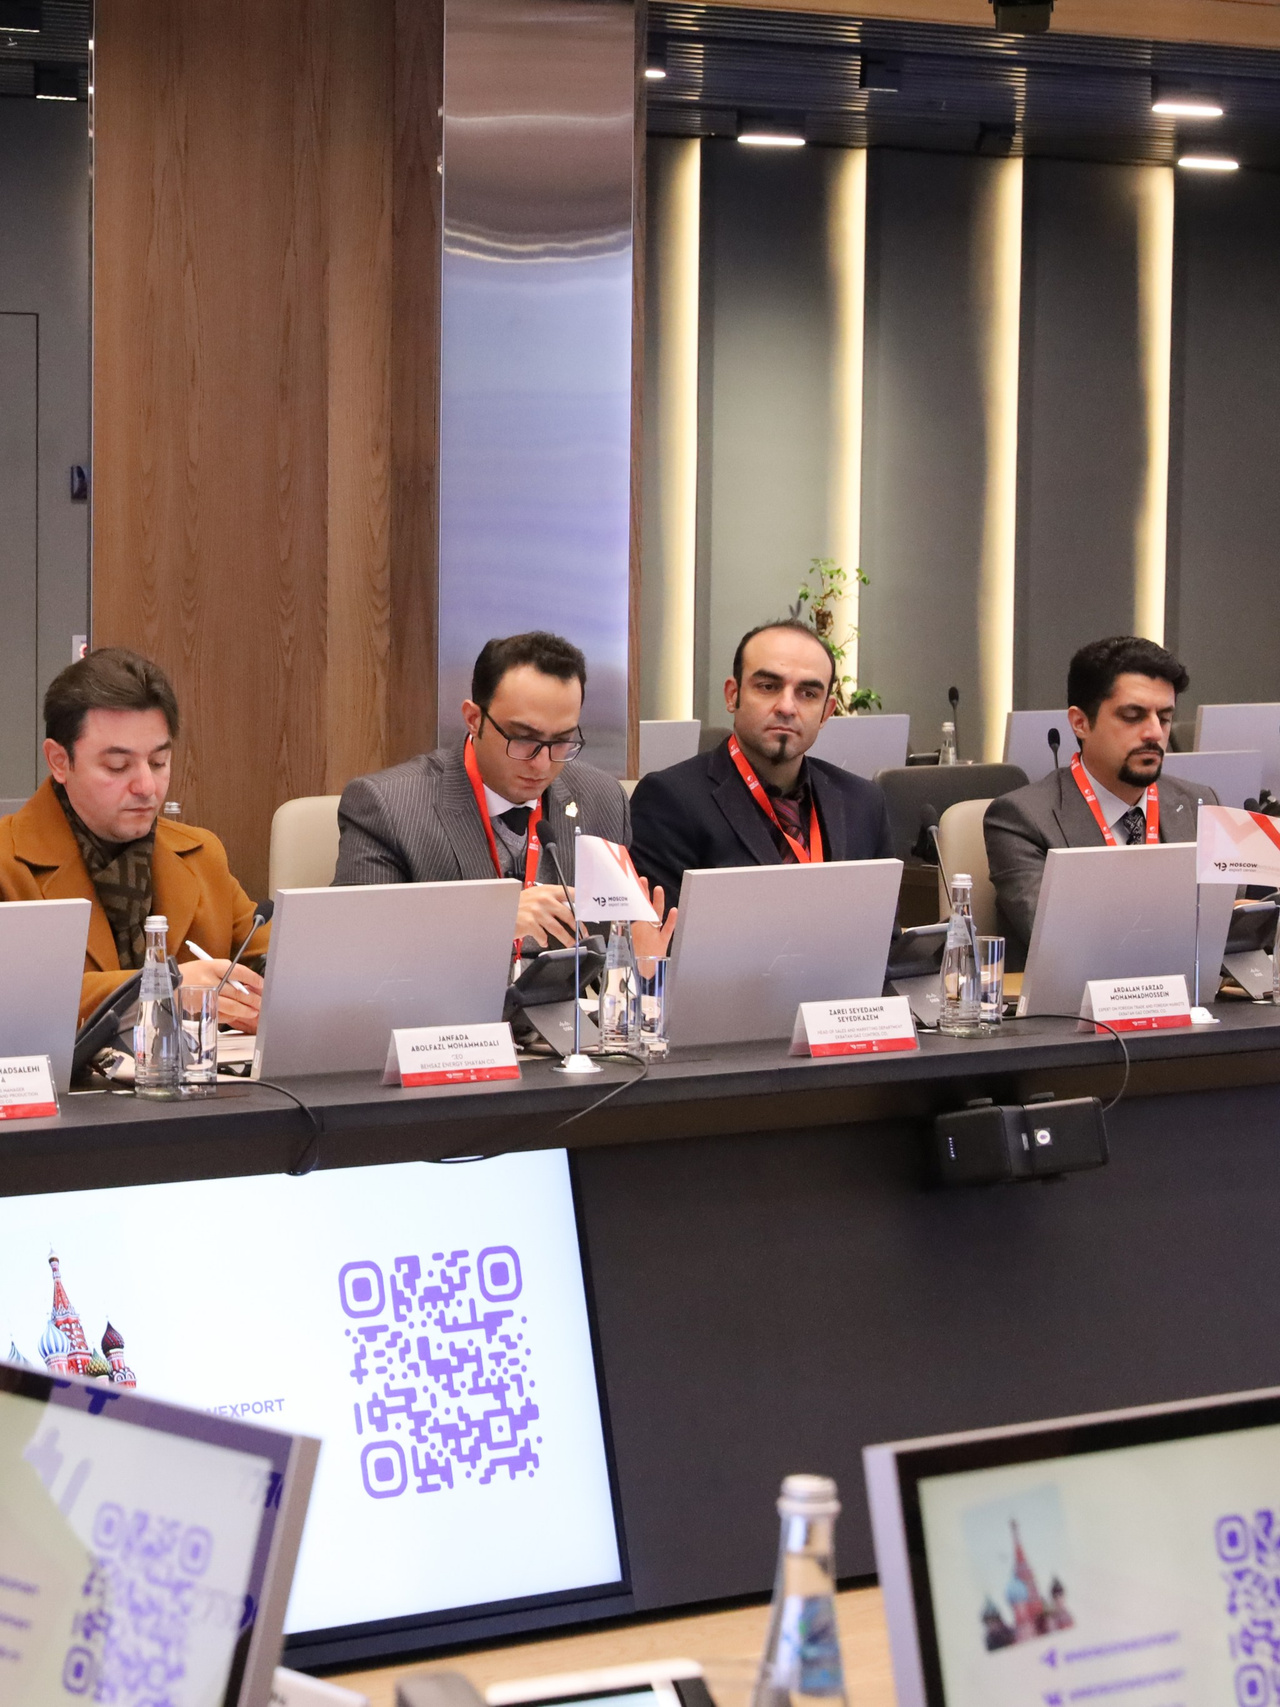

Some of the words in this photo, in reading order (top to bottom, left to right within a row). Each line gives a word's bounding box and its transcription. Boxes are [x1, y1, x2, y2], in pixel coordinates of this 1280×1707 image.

[1110, 991, 1170, 1001] MOHAMMADHOSSEIN
[829, 1008, 848, 1016] ZAREI
[849, 1006, 884, 1014] SEYEDAMIR
[838, 1015, 879, 1023] SEYEDKAZEM
[411, 1043, 446, 1052] ABOLFAZL
[447, 1040, 500, 1050] MOHAMMADALI
